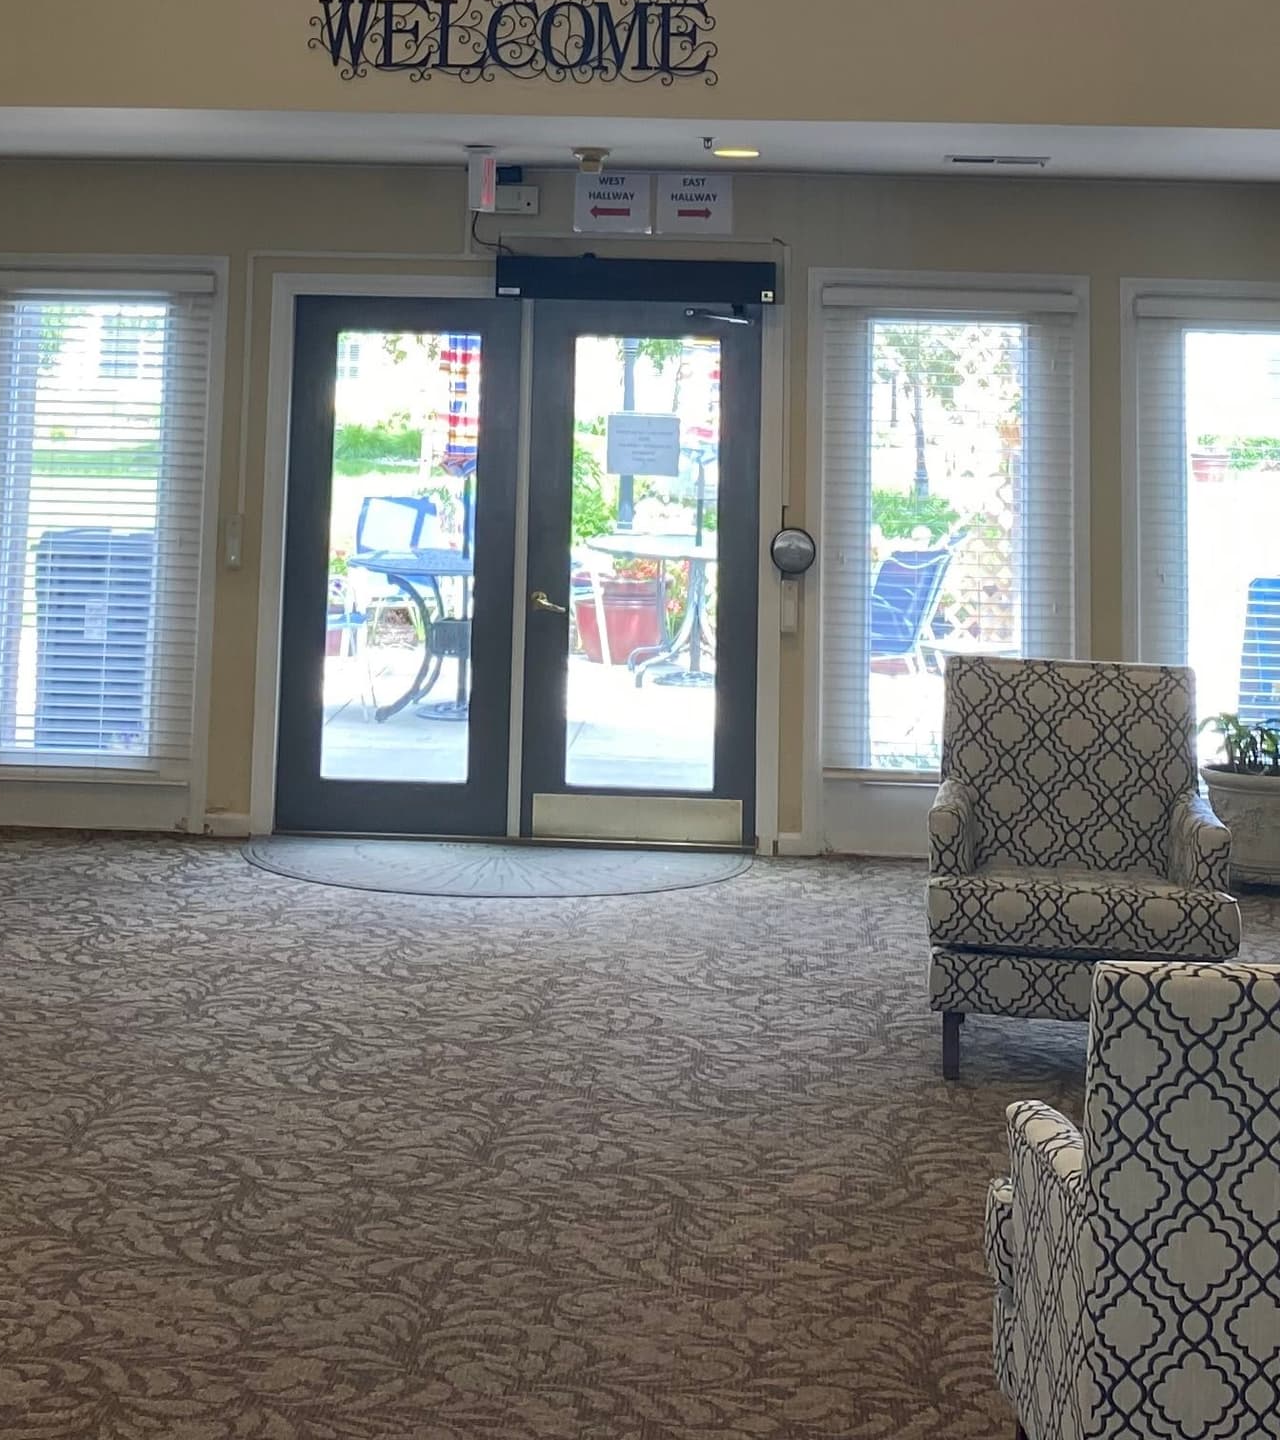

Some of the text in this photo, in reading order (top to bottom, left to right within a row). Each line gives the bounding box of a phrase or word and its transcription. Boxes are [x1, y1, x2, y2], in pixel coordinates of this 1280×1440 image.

[598, 176, 625, 186] WEST
[682, 177, 706, 187] EAST
[588, 190, 635, 201] HALLWAY
[670, 192, 718, 203] HALLWAY
